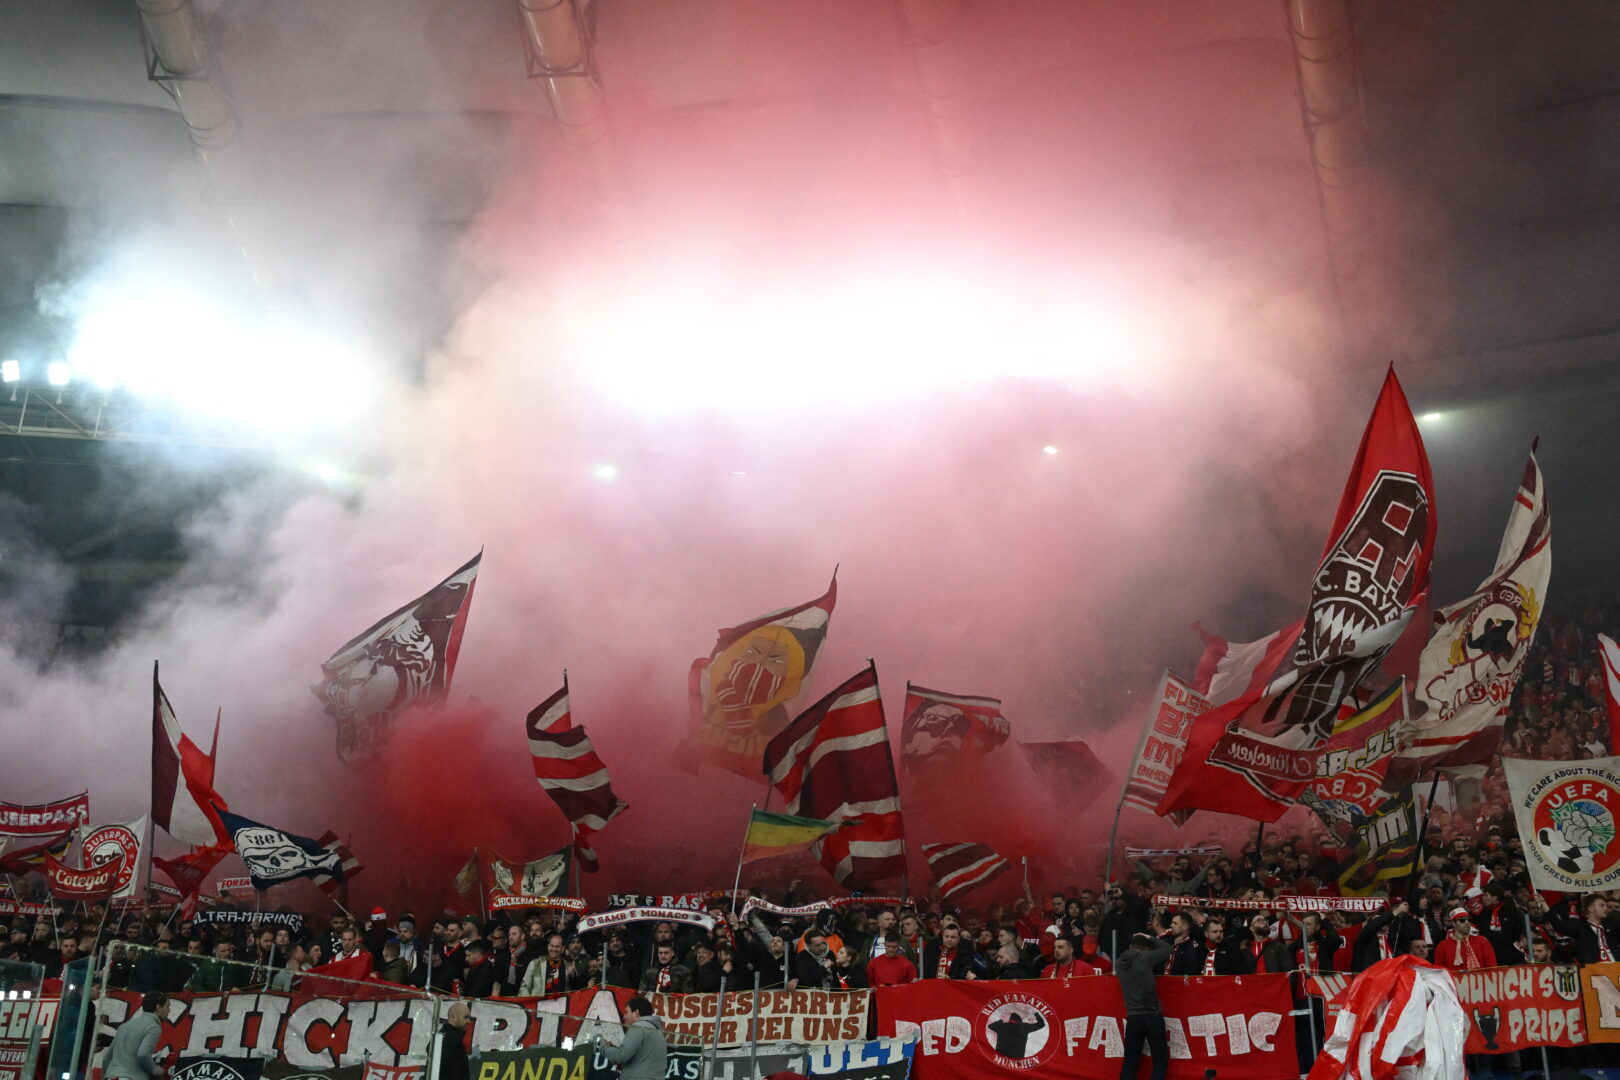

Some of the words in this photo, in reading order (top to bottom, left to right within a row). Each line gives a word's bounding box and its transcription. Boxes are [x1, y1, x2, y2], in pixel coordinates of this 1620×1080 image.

[1524, 796, 1535, 808] WE
[1532, 776, 1553, 797] CARE
[1554, 768, 1584, 780] ABOUT
[1587, 768, 1604, 777] THE
[1547, 784, 1608, 808] UEFA
[86, 831, 134, 852] QUEERPASS
[1528, 840, 1543, 864] YOUR
[1543, 864, 1572, 885] GREED
[1574, 879, 1603, 888] KILLS
[641, 910, 689, 920] MONACO
[652, 991, 868, 1021] AUSGESPERRTE
[981, 995, 1003, 1018] RED
[1003, 990, 1054, 1019] FANATIC
[660, 1020, 738, 1044] MMER
[745, 1016, 794, 1044] BEI
[802, 1016, 861, 1042] UNS
[1063, 1010, 1283, 1060] FAATIC
[1507, 1007, 1583, 1044] PRIDE
[992, 1053, 1041, 1070] MÜNCHEN
